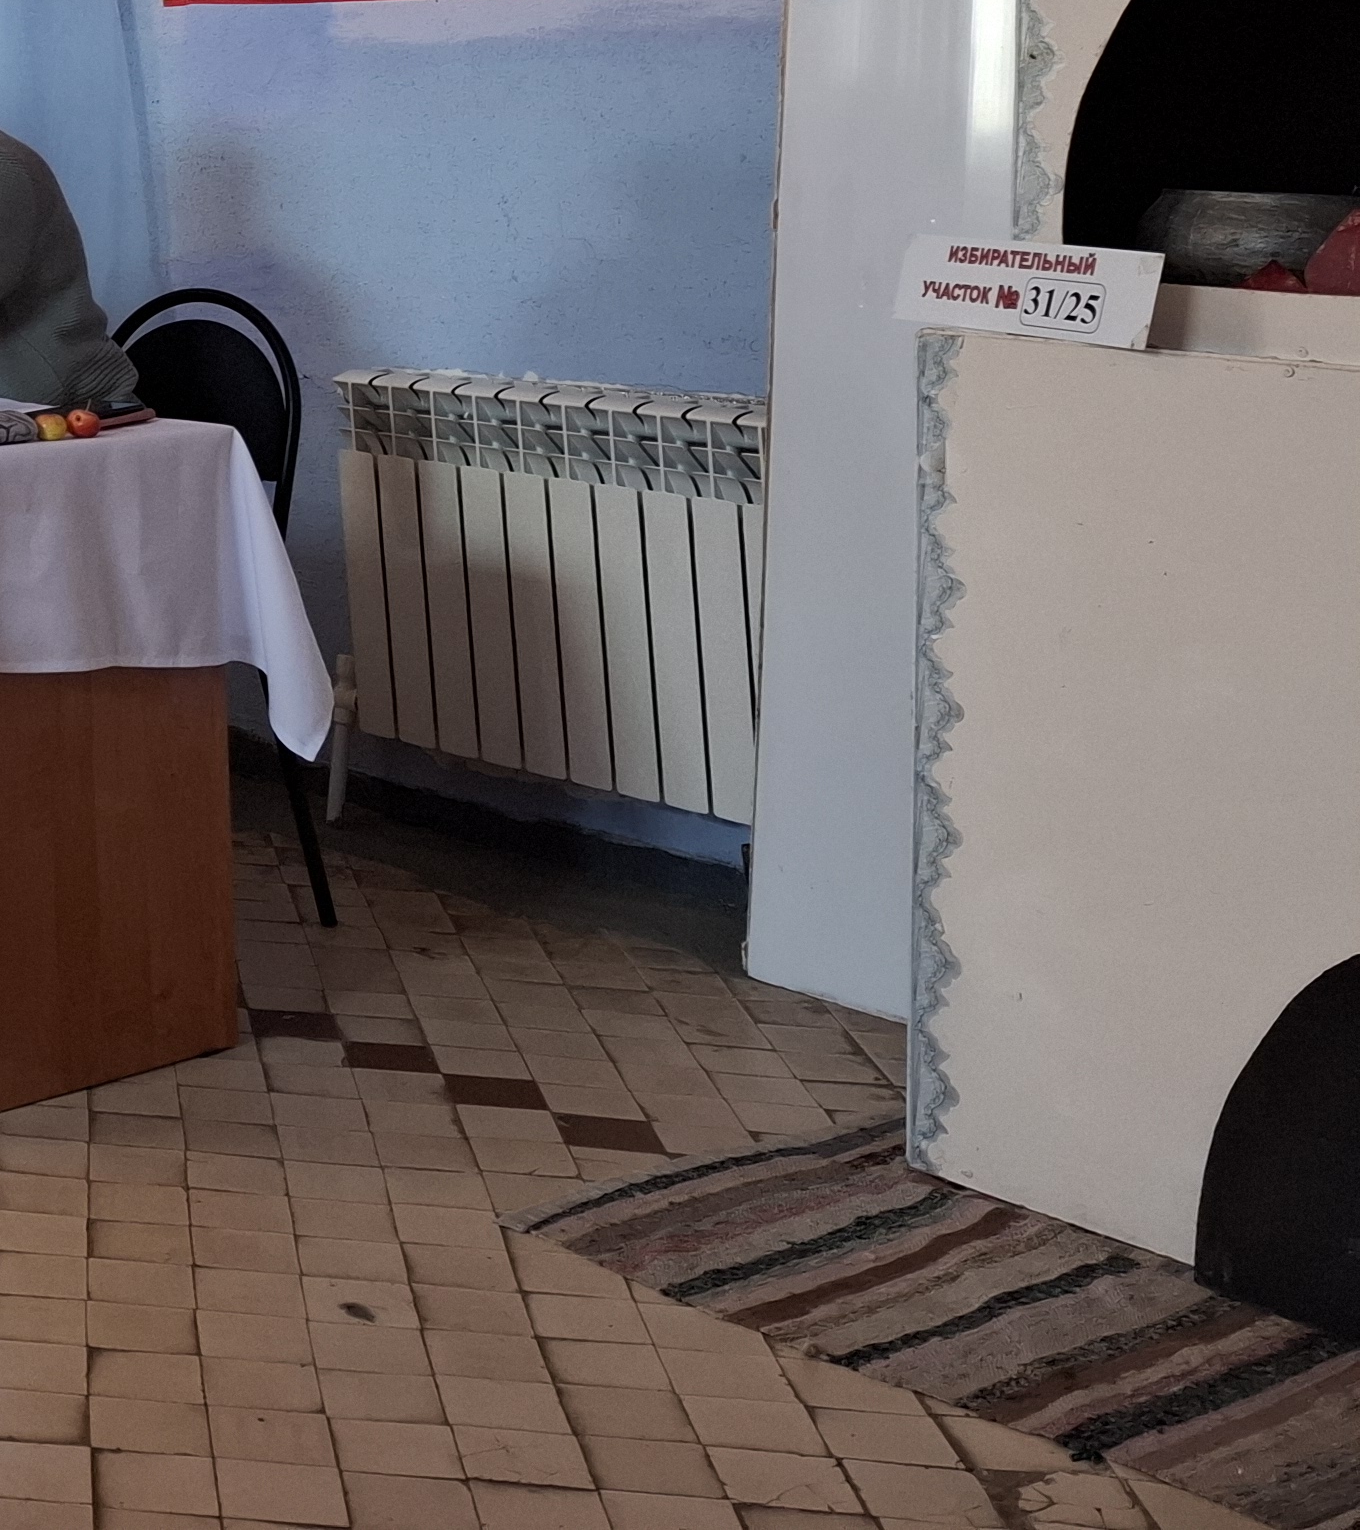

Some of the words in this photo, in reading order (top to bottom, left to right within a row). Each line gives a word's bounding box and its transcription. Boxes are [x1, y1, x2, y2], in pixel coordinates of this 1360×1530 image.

[947, 244, 1098, 276] ИЗБИРАТЕЛЬНЫЙ
[921, 280, 992, 305] УЧАСТОК
[994, 284, 1021, 310] №
[1023, 285, 1101, 325] 31/25
